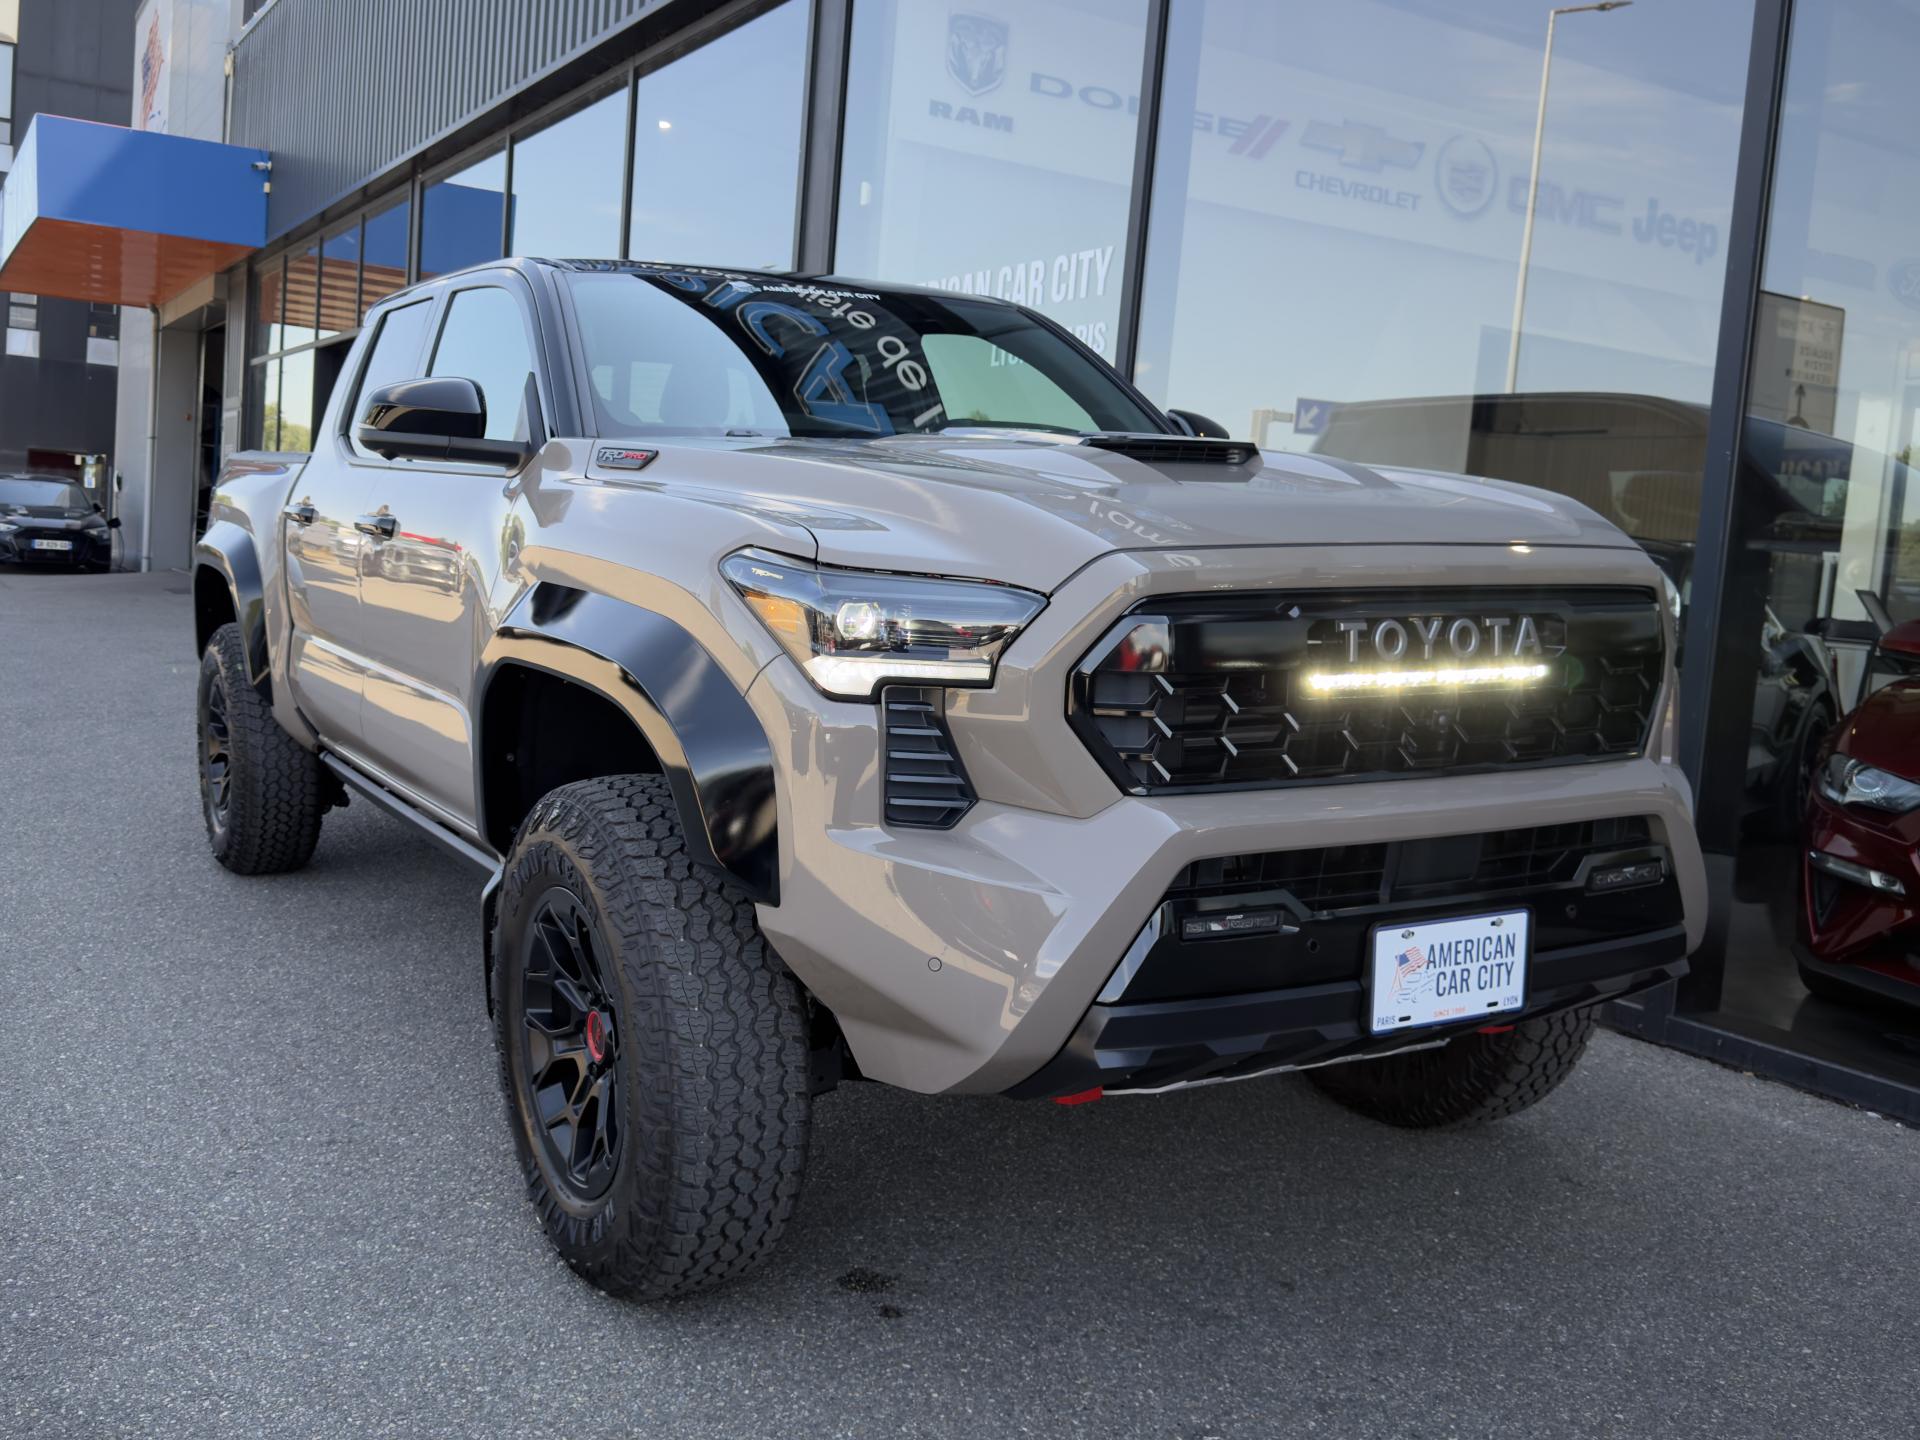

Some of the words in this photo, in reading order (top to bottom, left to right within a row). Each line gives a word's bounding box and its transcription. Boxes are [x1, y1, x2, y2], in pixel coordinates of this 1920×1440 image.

[929, 99, 1014, 133] RAM
[1295, 169, 1421, 212] CHEVROLET
[1631, 196, 1719, 266] Jeep
[1051, 245, 1114, 304] CITY
[855, 292, 881, 301] CITY
[1336, 615, 1543, 663] TOYOTA
[1426, 933, 1516, 970] AMERICAN
[1436, 967, 1470, 997] CAR
[1478, 961, 1515, 990] CITY
[1503, 995, 1519, 1007] LYON
[1377, 1015, 1396, 1027] PARIS
